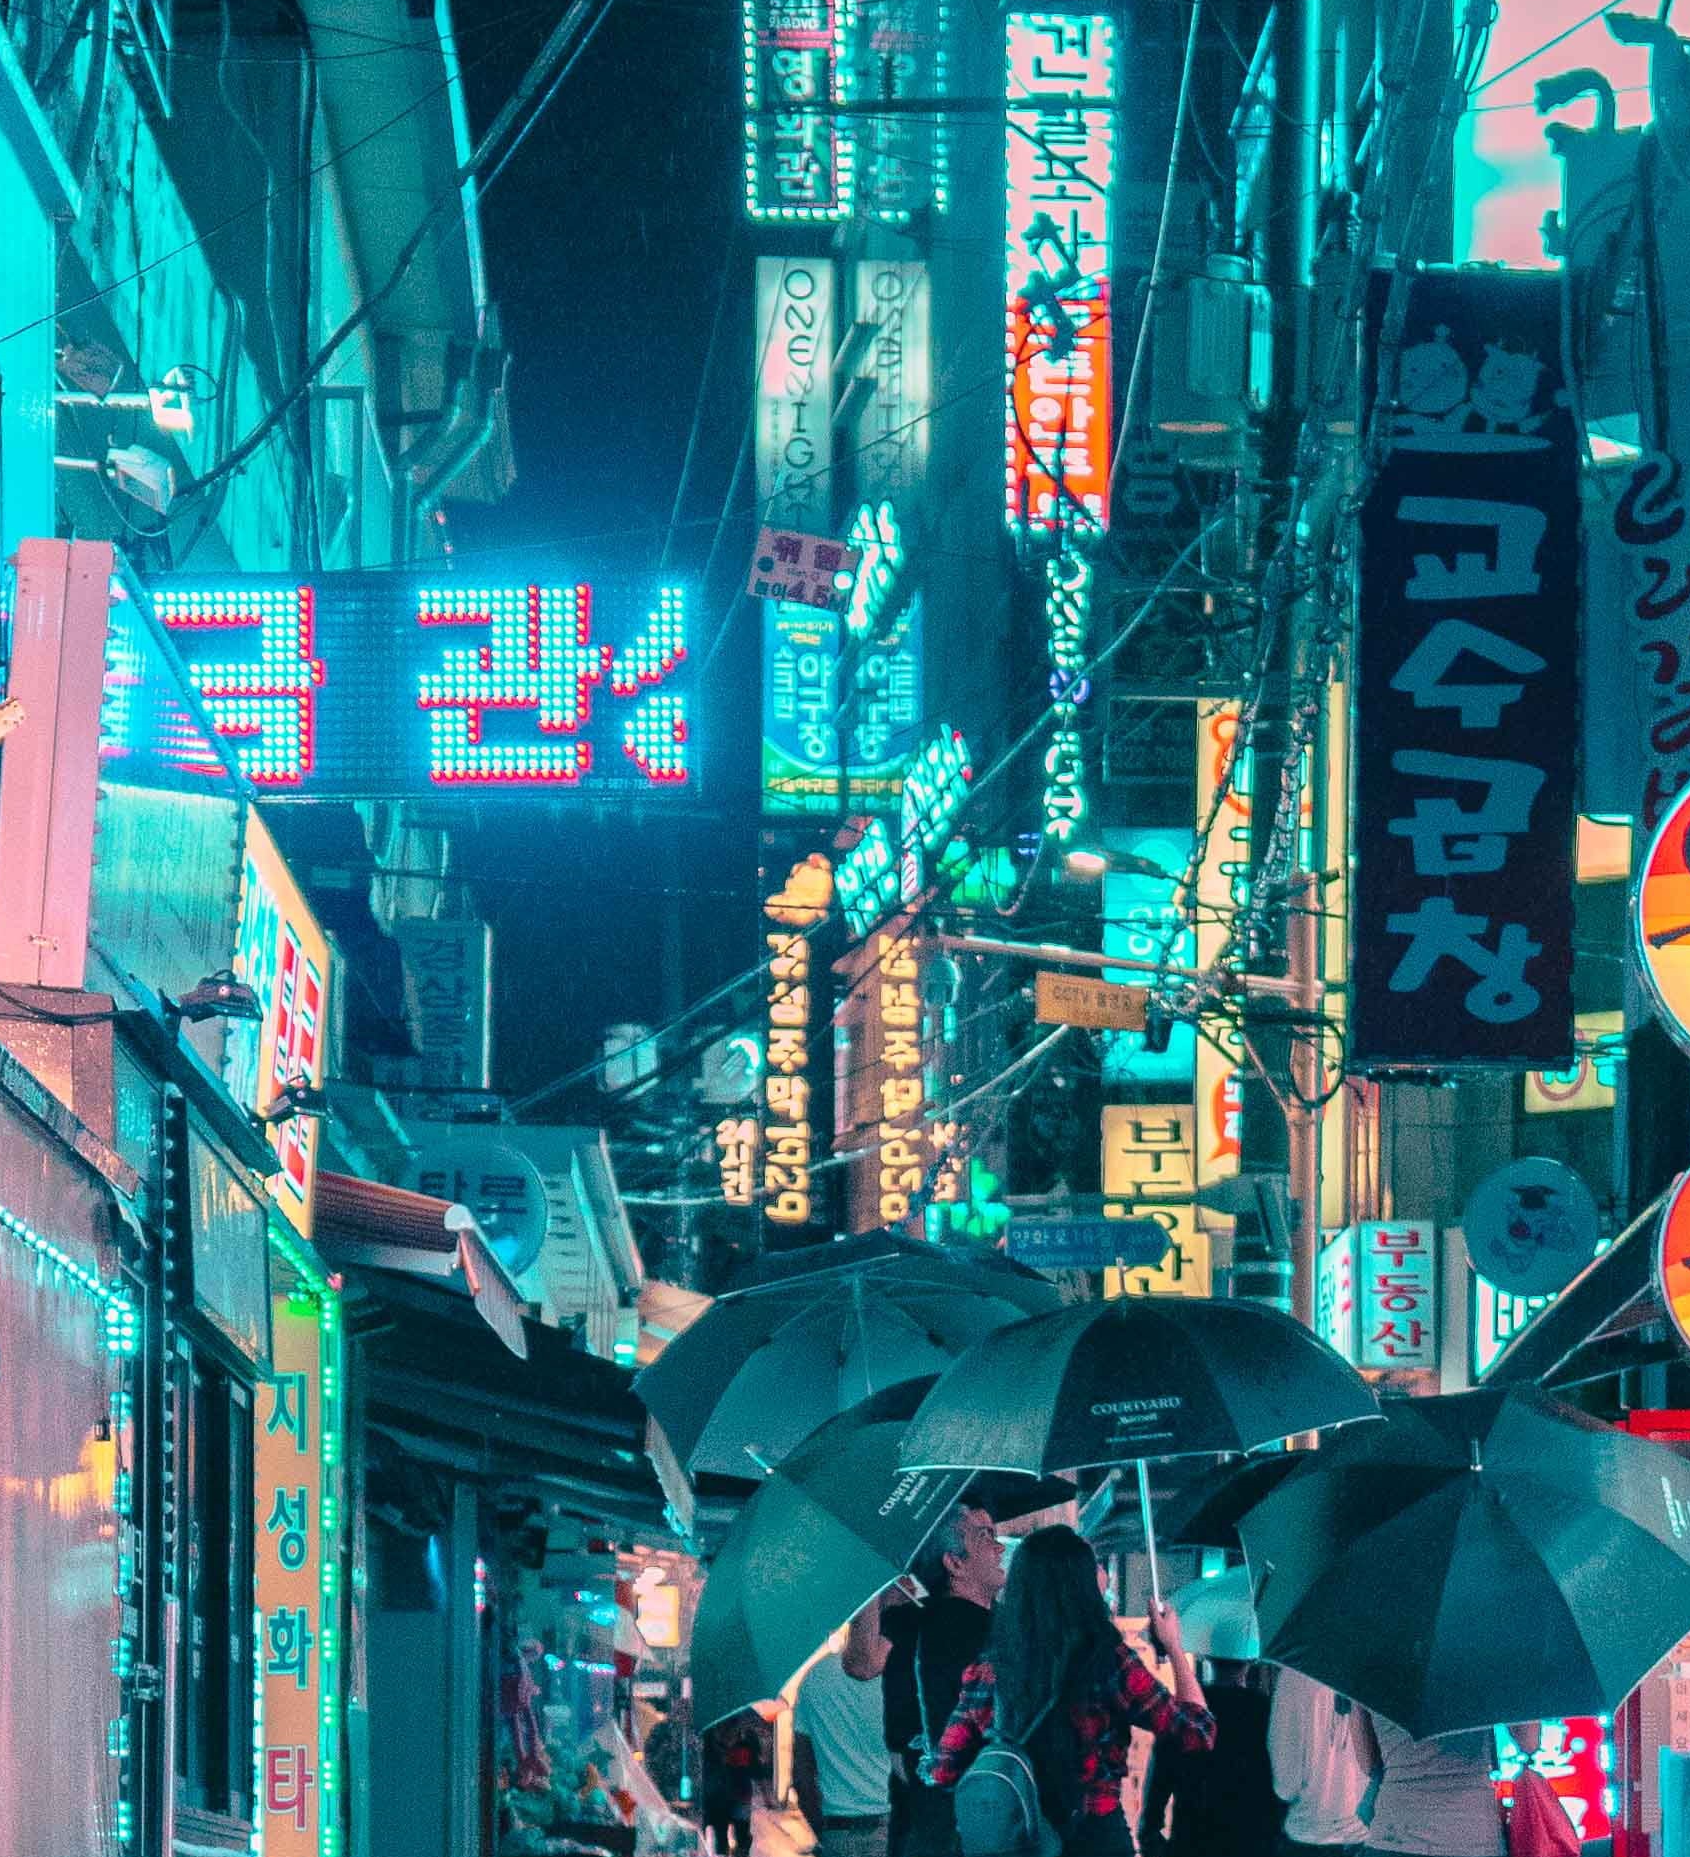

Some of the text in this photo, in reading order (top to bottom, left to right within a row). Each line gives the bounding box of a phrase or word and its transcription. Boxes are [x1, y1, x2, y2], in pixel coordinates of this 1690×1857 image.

[797, 653, 832, 759] 야구장
[1387, 495, 1549, 1025] 교수곱창
[1372, 1230, 1431, 1357] 부동산
